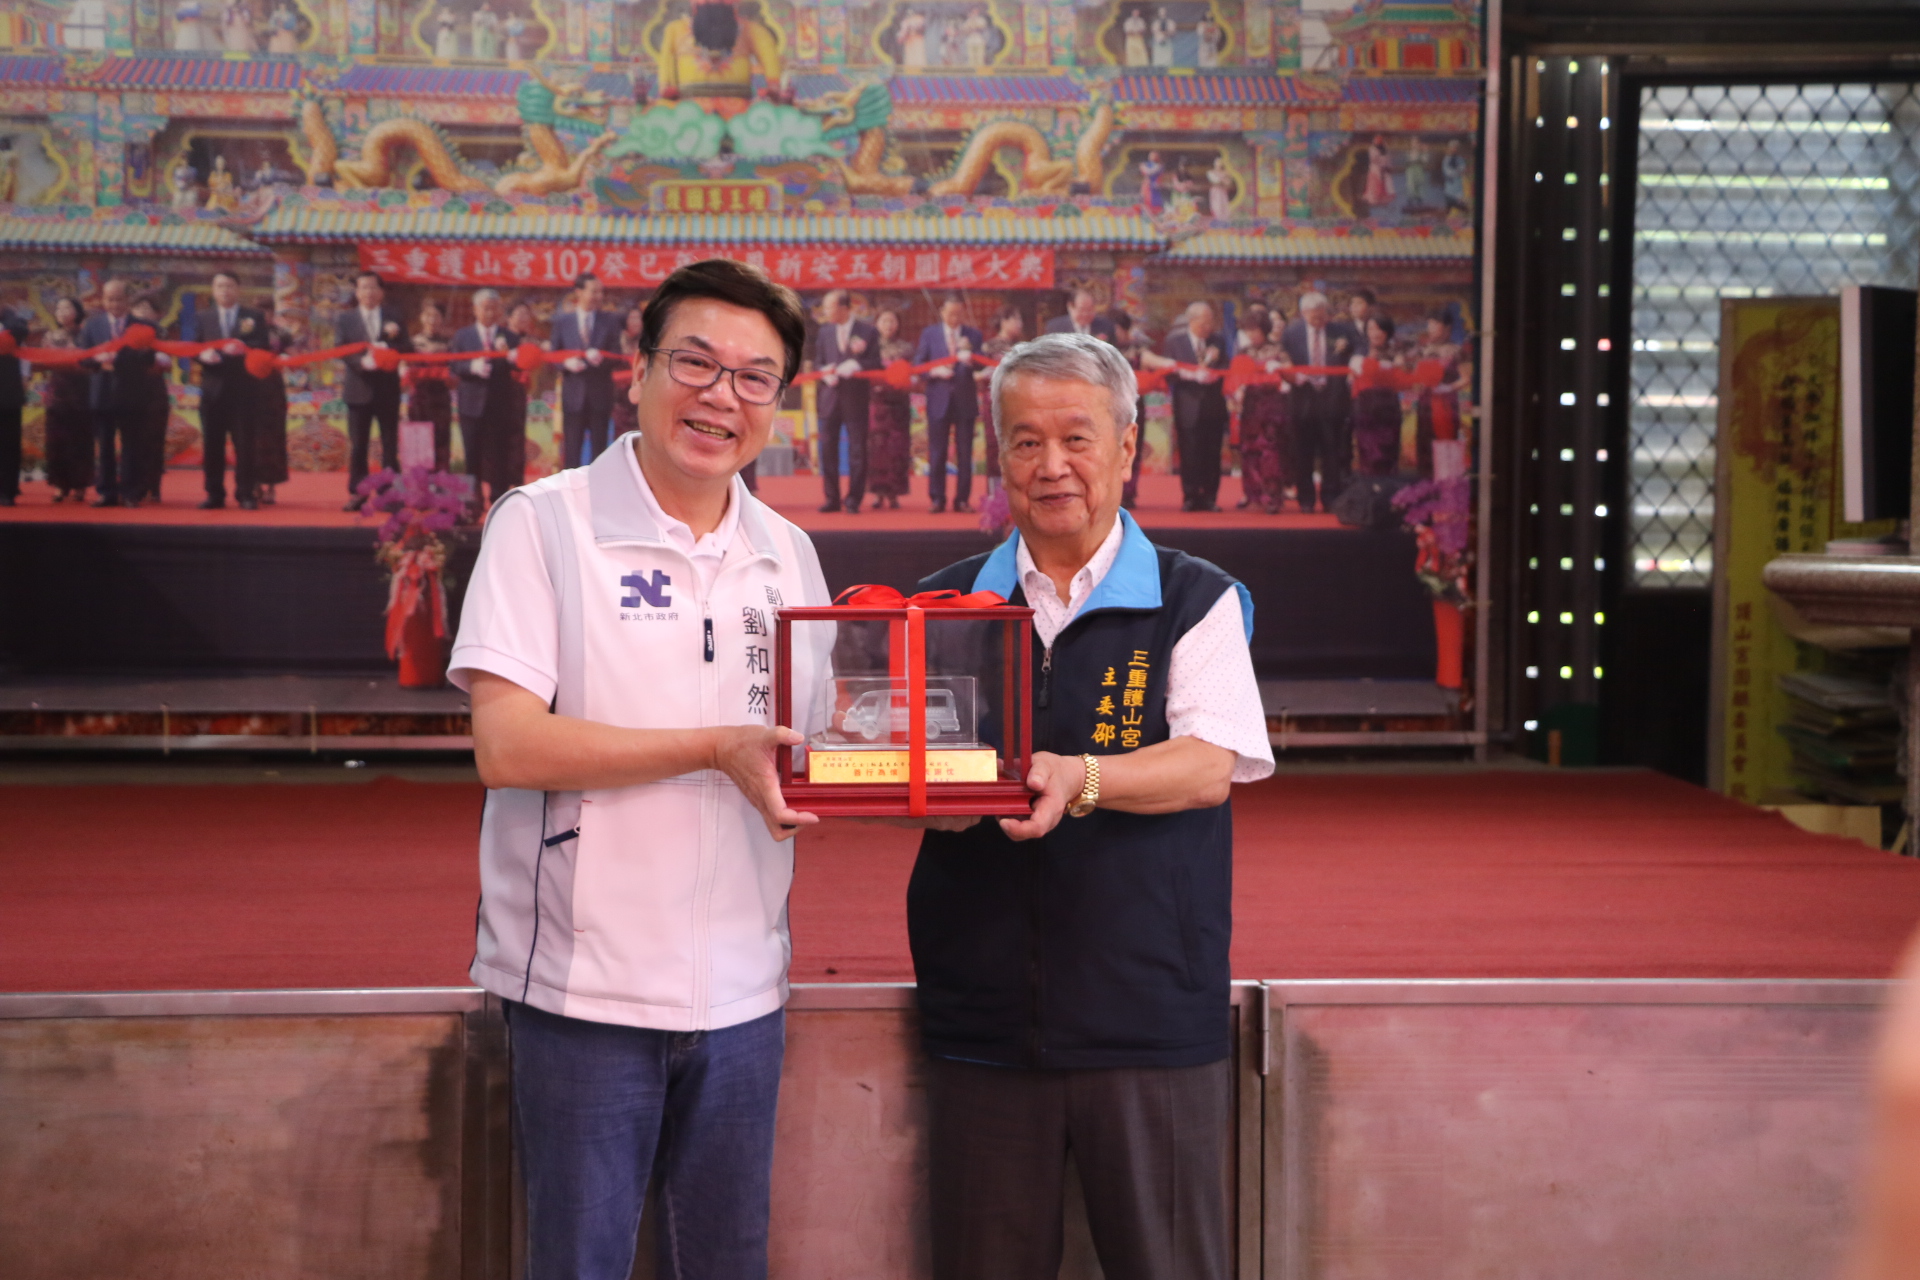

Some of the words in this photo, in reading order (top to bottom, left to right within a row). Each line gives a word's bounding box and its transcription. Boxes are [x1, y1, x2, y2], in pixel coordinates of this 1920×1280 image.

[619, 612, 679, 621] 新北市政府
[742, 606, 770, 715] 劉和然
[1091, 667, 1117, 747] 主委邵
[1121, 650, 1150, 747] 三重護山宮
